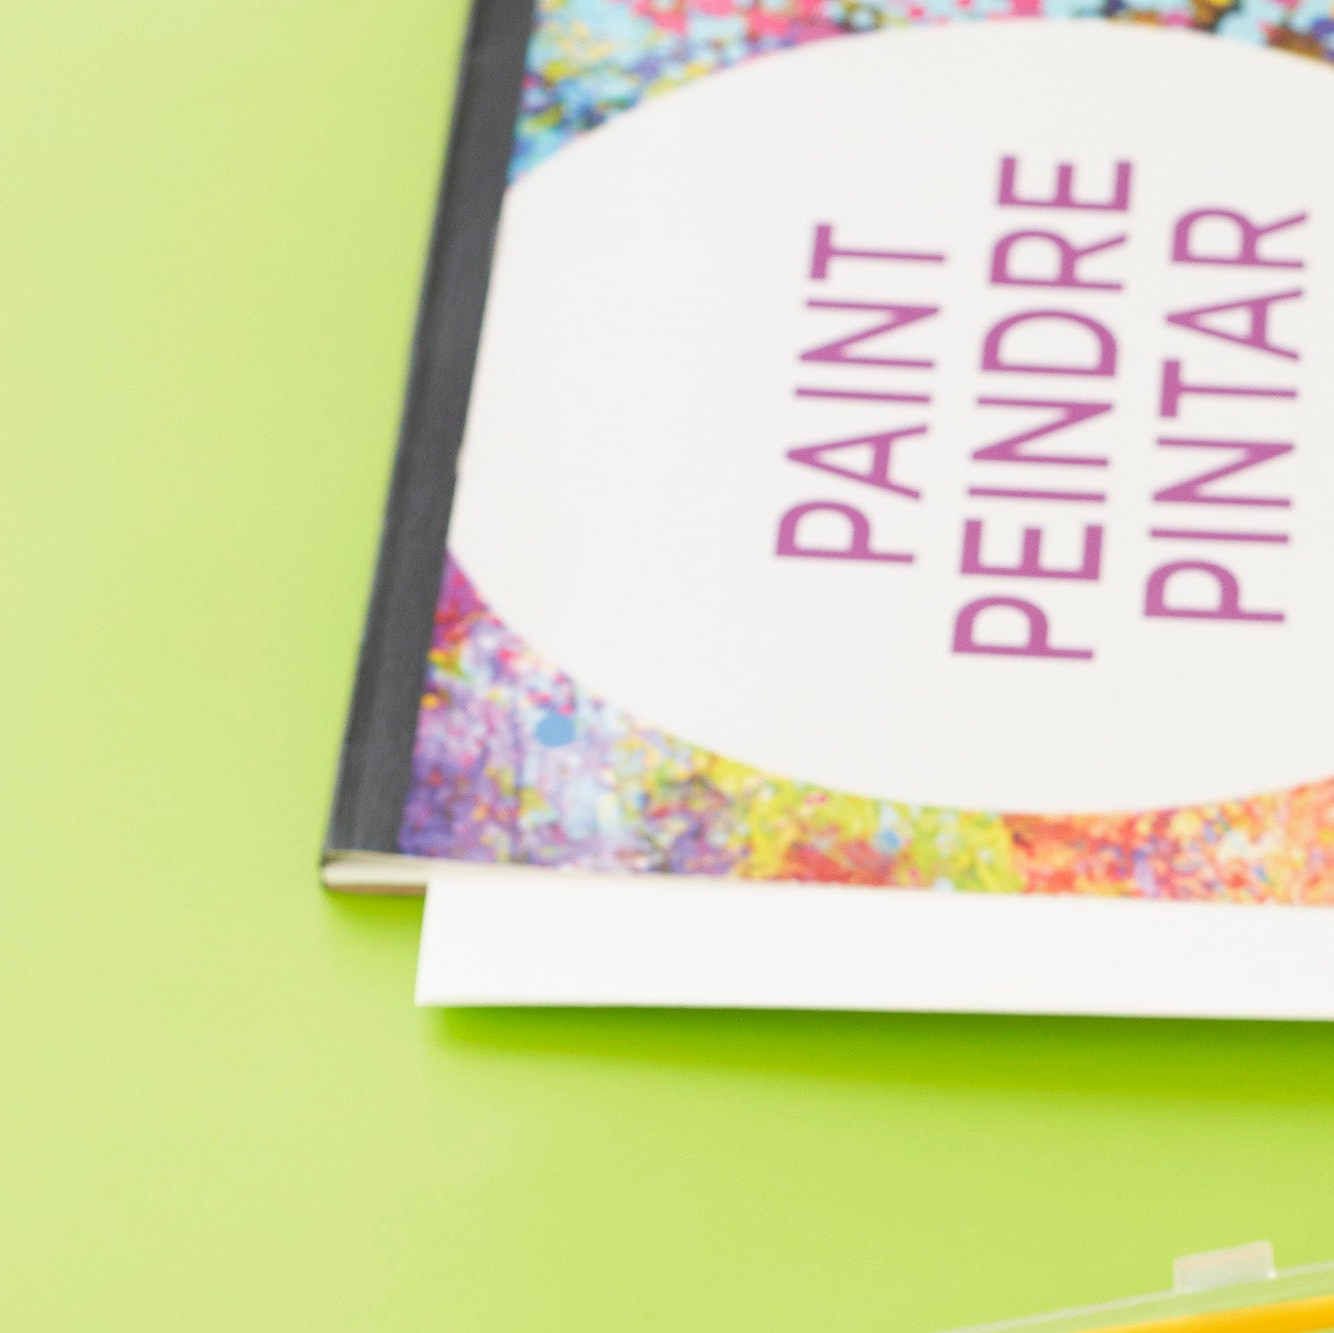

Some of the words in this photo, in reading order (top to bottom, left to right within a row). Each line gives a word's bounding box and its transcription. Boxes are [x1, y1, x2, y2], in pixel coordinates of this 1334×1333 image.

[775, 224, 945, 564] PAINT
[952, 156, 1132, 661] PEINDRE
[1143, 208, 1306, 623] PINTAR
